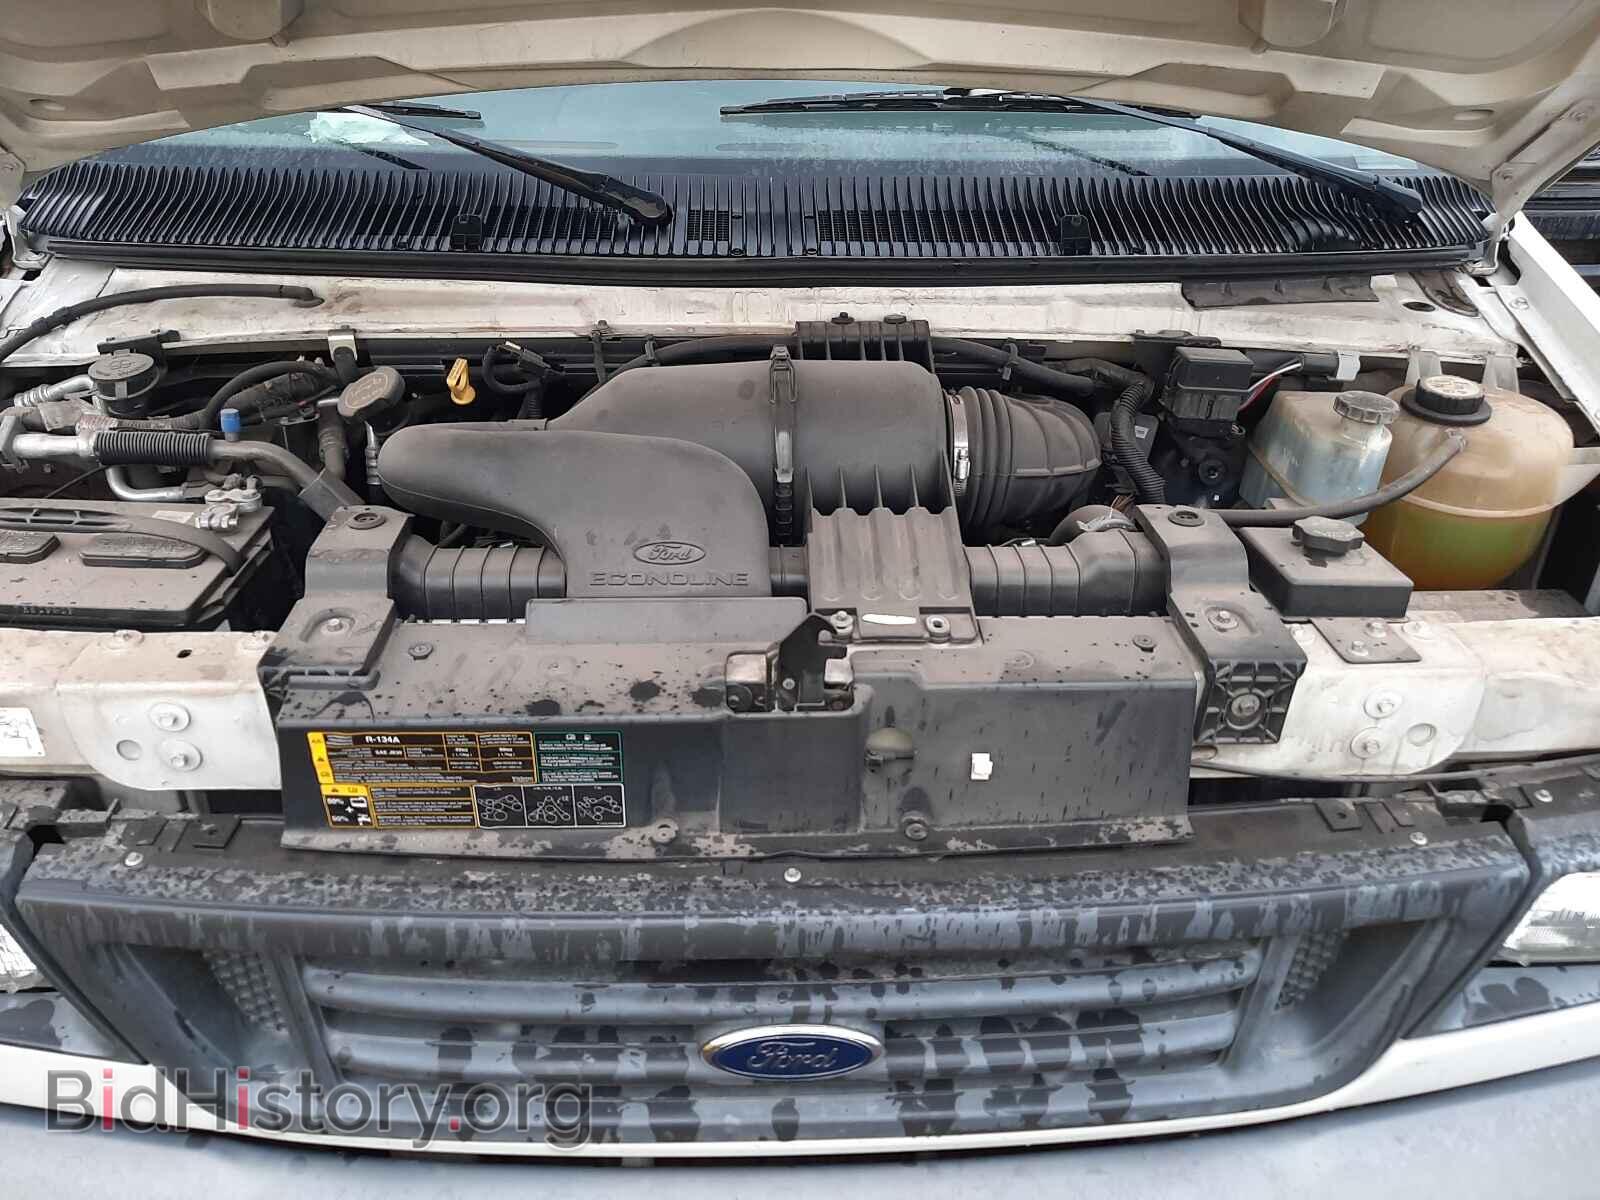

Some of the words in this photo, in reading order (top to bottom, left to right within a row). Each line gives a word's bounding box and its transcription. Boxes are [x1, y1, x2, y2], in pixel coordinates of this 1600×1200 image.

[648, 544, 692, 561] Ford
[589, 572, 749, 586] ECONOLINE
[364, 735, 401, 744] R-134A
[747, 1040, 839, 1069] Ford
